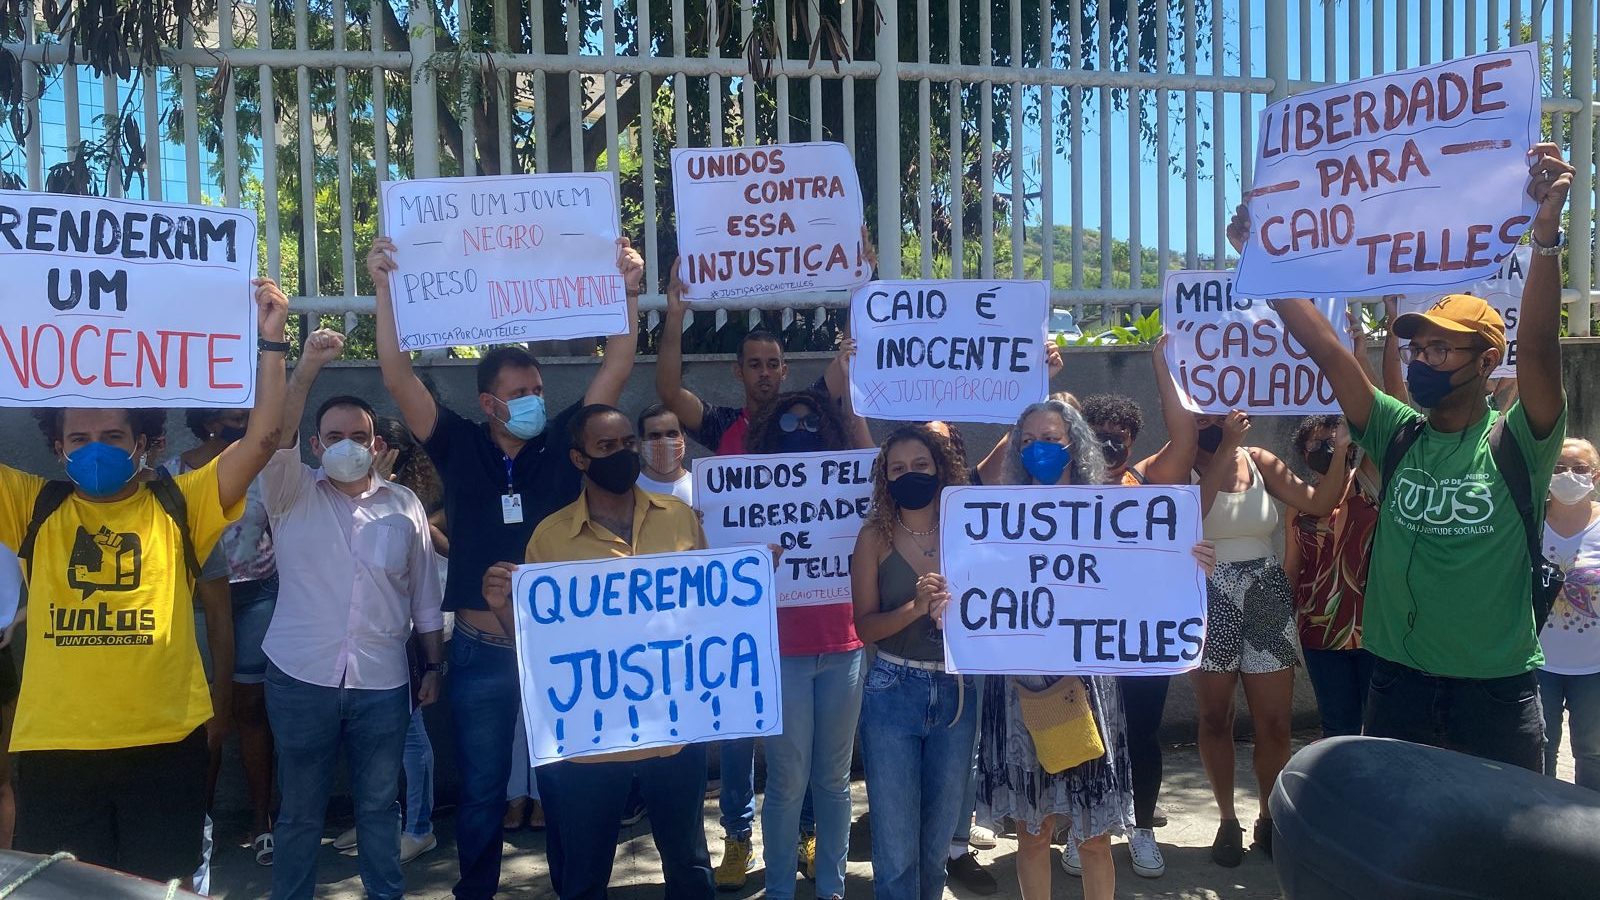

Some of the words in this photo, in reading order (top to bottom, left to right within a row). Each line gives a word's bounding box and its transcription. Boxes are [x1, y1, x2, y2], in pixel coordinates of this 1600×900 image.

[687, 149, 786, 180] UNIDOS
[1315, 138, 1431, 197] PARA
[399, 193, 459, 226] MAIS
[471, 193, 508, 217] UM
[513, 187, 591, 214] JOVEM
[744, 175, 845, 205] CONTRA
[462, 224, 544, 257] NEGRO
[727, 212, 796, 238] ESSA
[1260, 204, 1355, 256] CAIO
[1357, 215, 1531, 275] TELLES
[47, 268, 128, 311] UM
[404, 268, 478, 304] PRESO
[487, 274, 627, 320] INJUSTAMENTE
[866, 289, 948, 322] CAIO
[975, 286, 1003, 320] É
[876, 336, 1034, 373] INOCENTE
[706, 462, 808, 494] UNIDOS
[723, 497, 871, 528] LIBERDADE
[1398, 477, 1495, 525] UJS
[780, 531, 813, 551] DE
[1453, 525, 1495, 536] SOCIALISTA
[1028, 553, 1101, 583] POR
[528, 556, 763, 624] QUEREMOS
[960, 586, 1055, 631] CAIO
[44, 602, 156, 639] juntos
[59, 635, 149, 646] JUNTOS.ORG.BR
[1058, 617, 1204, 663] TELLES
